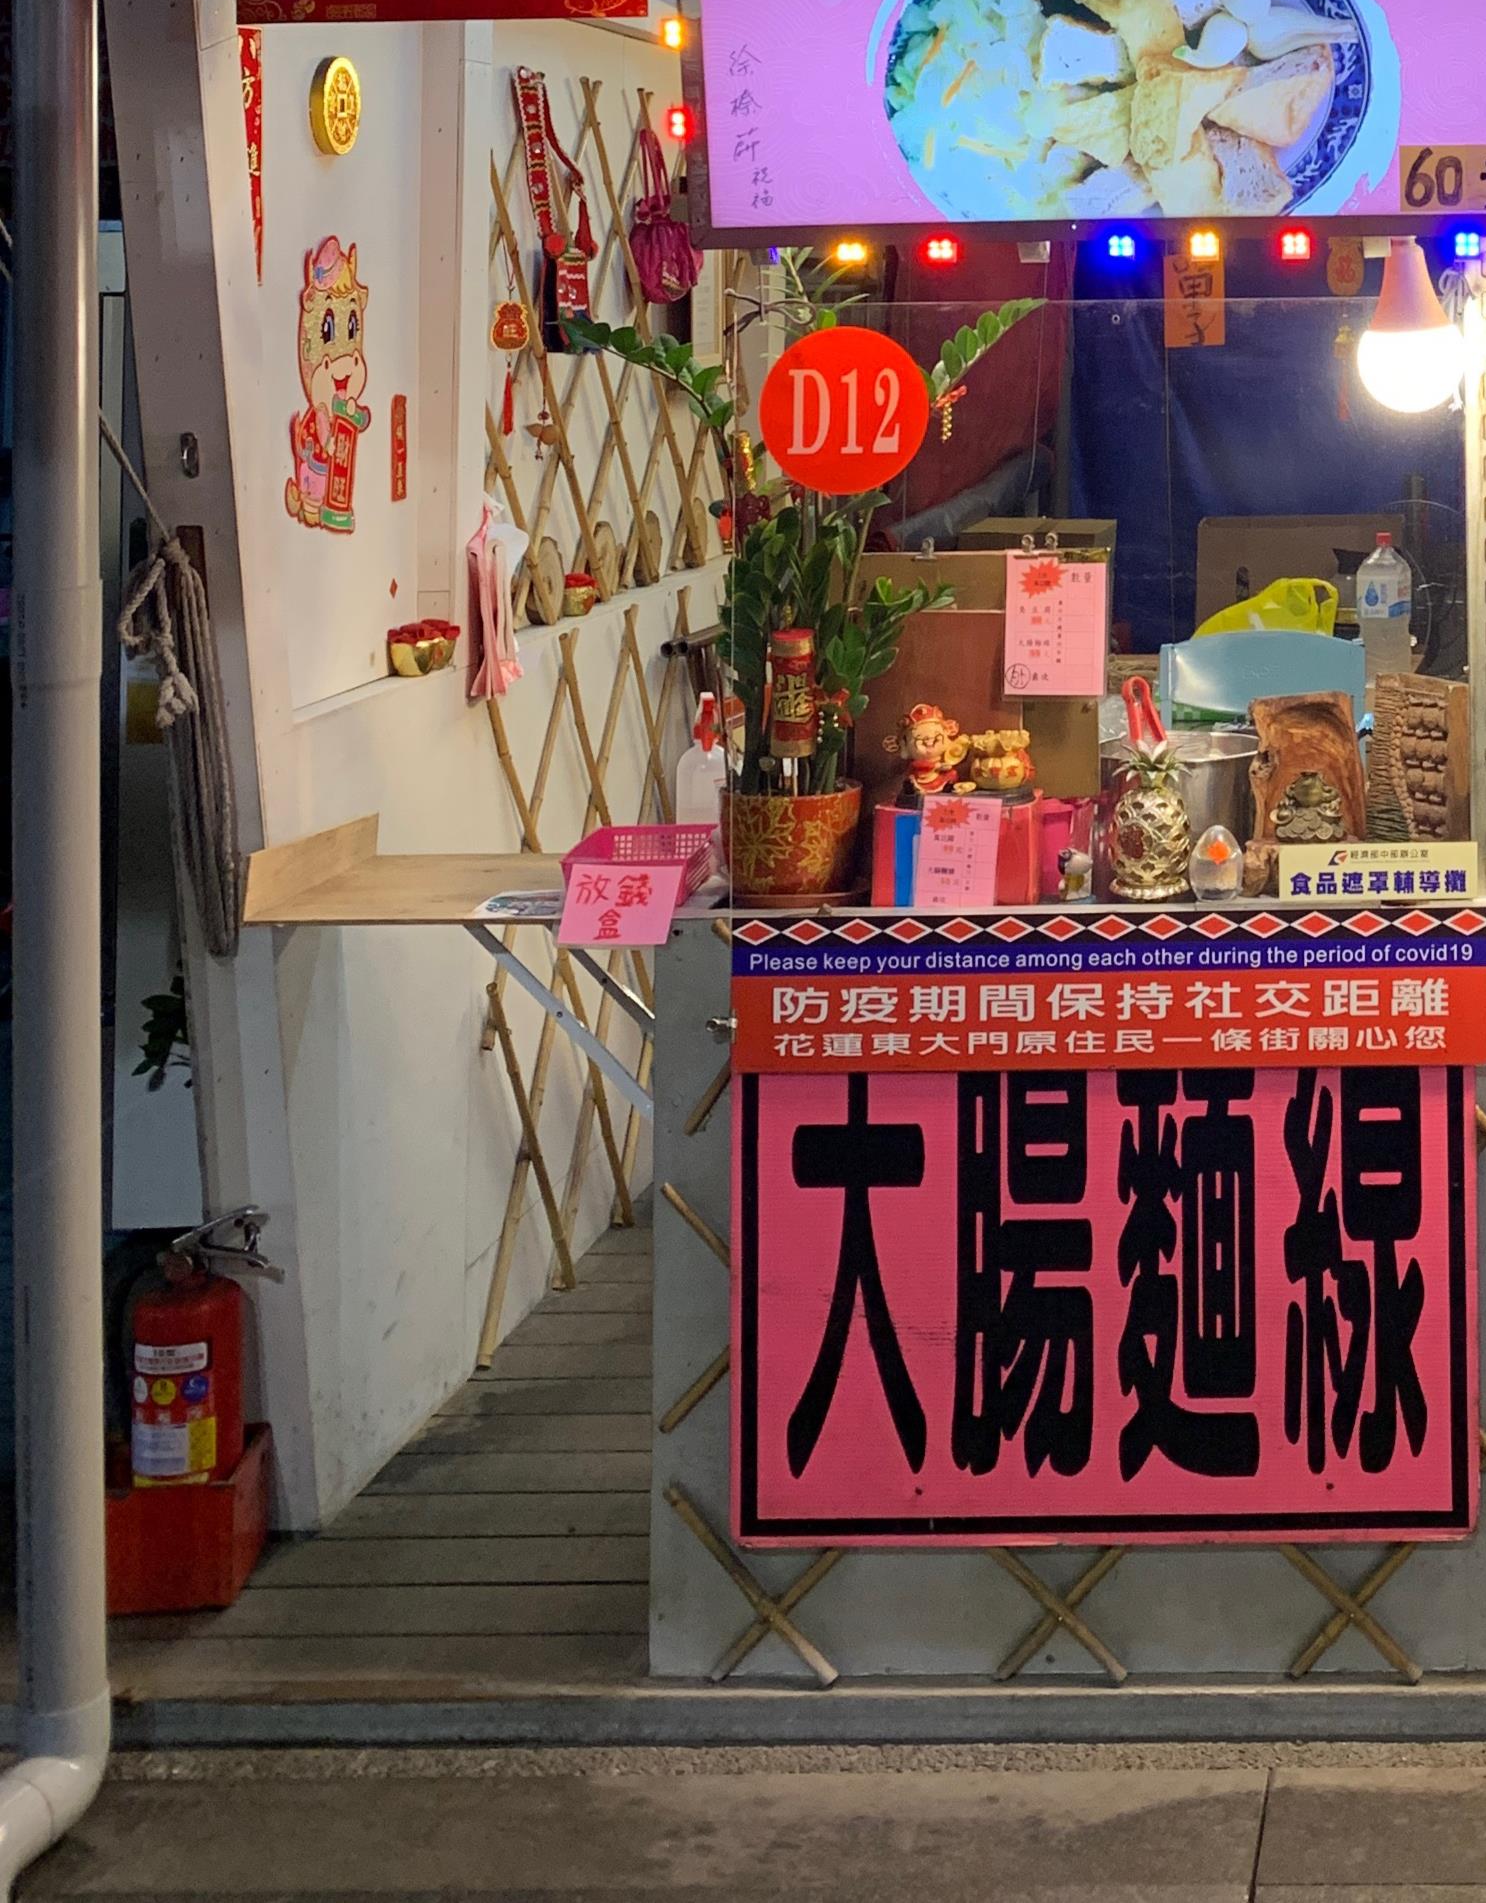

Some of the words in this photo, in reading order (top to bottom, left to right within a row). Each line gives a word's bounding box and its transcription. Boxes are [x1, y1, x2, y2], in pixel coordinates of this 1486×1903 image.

[786, 367, 900, 455] D12
[575, 873, 653, 907] 放錢
[1290, 869, 1468, 896] 食品遮罩輔導攤
[593, 908, 622, 941] 盒
[750, 952, 818, 971] Please
[823, 952, 871, 973] keep
[876, 955, 920, 973] your
[925, 951, 1010, 969] distance
[1015, 953, 1083, 971] among
[1088, 949, 1136, 967] each
[1141, 949, 1194, 966] other
[1198, 948, 1261, 968] during
[1266, 947, 1298, 964] the
[1303, 945, 1365, 967] period
[1370, 944, 1393, 962] of
[1395, 943, 1473, 962] covid19
[772, 977, 1449, 1025] 防疫期間保持社交距離
[773, 1025, 1448, 1057] 花蓮東大門原住民一條街關心您
[785, 1066, 1429, 1483] 大腸麵線
